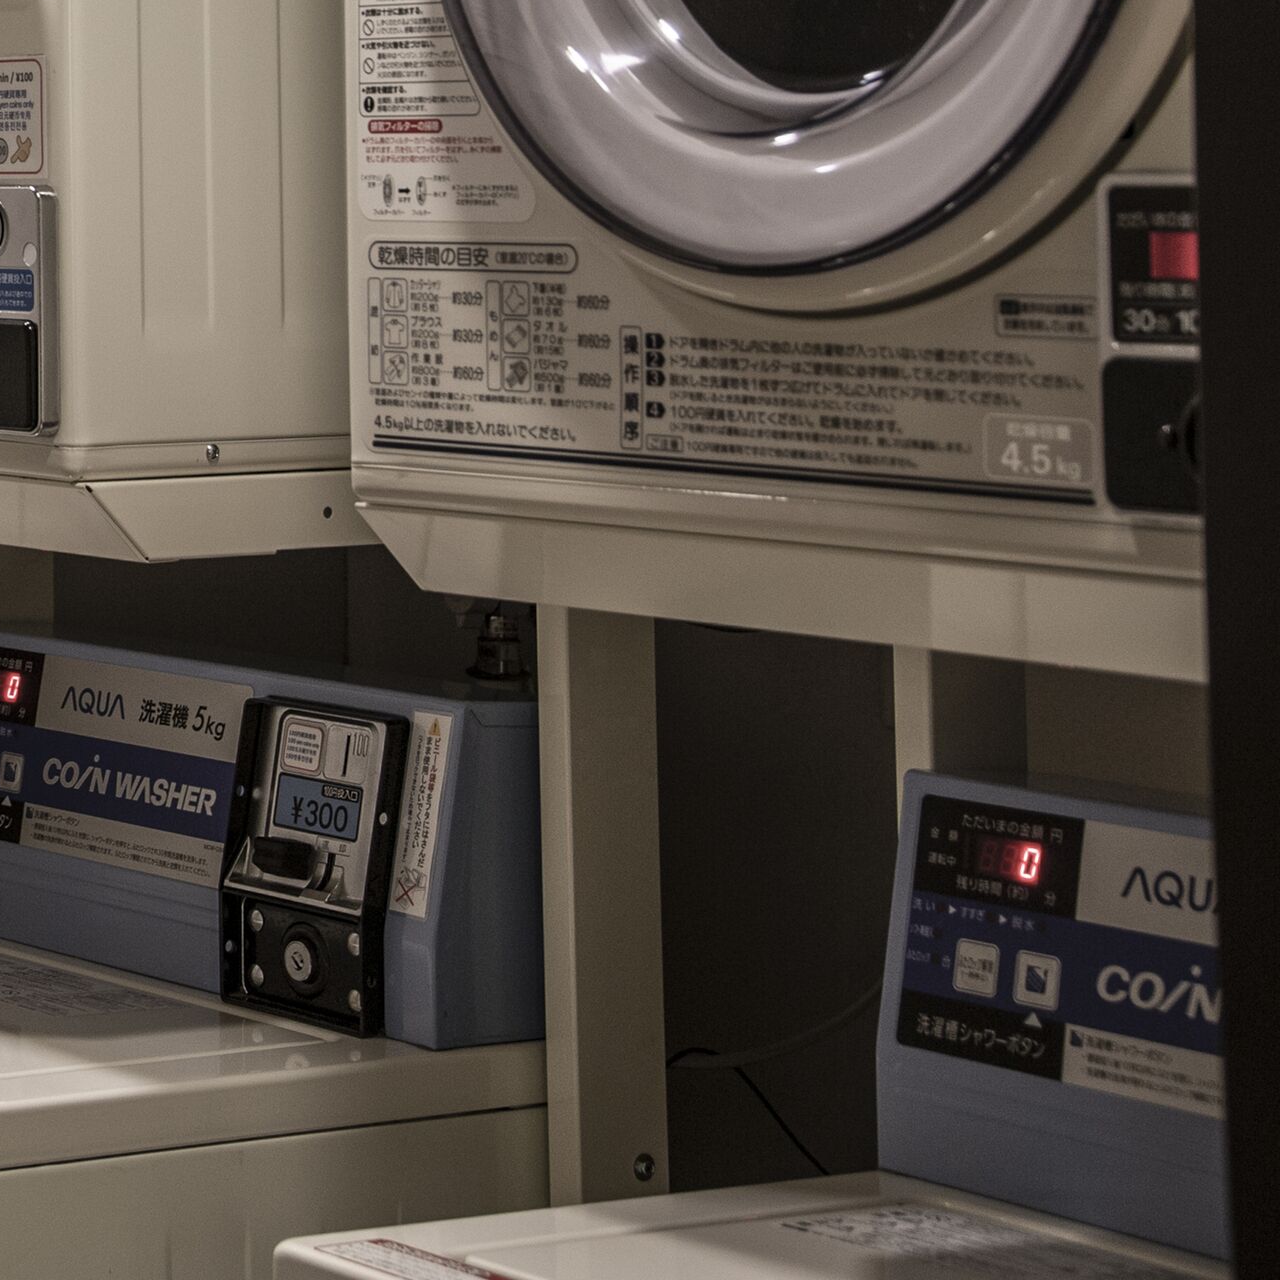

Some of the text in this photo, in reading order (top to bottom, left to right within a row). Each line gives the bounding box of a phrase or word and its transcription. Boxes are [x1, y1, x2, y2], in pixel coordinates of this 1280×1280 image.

[378, 247, 489, 267] 乾燥時間の目安
[410, 316, 442, 327] ブラウス
[623, 334, 639, 441] 操作順序
[25, 661, 33, 673] 円
[6, 675, 21, 699] 0
[61, 686, 126, 719] AQUA
[139, 697, 227, 742] 洗濯機 5kg
[352, 732, 370, 757] 100
[115, 772, 217, 817] WASHER
[291, 795, 349, 832] ¥300
[961, 814, 1064, 843] ただいまの金額 円
[1019, 847, 1040, 879] 0
[1044, 892, 1057, 906] 分
[916, 1011, 1045, 1058] 洗濯槽シャワーボタン
